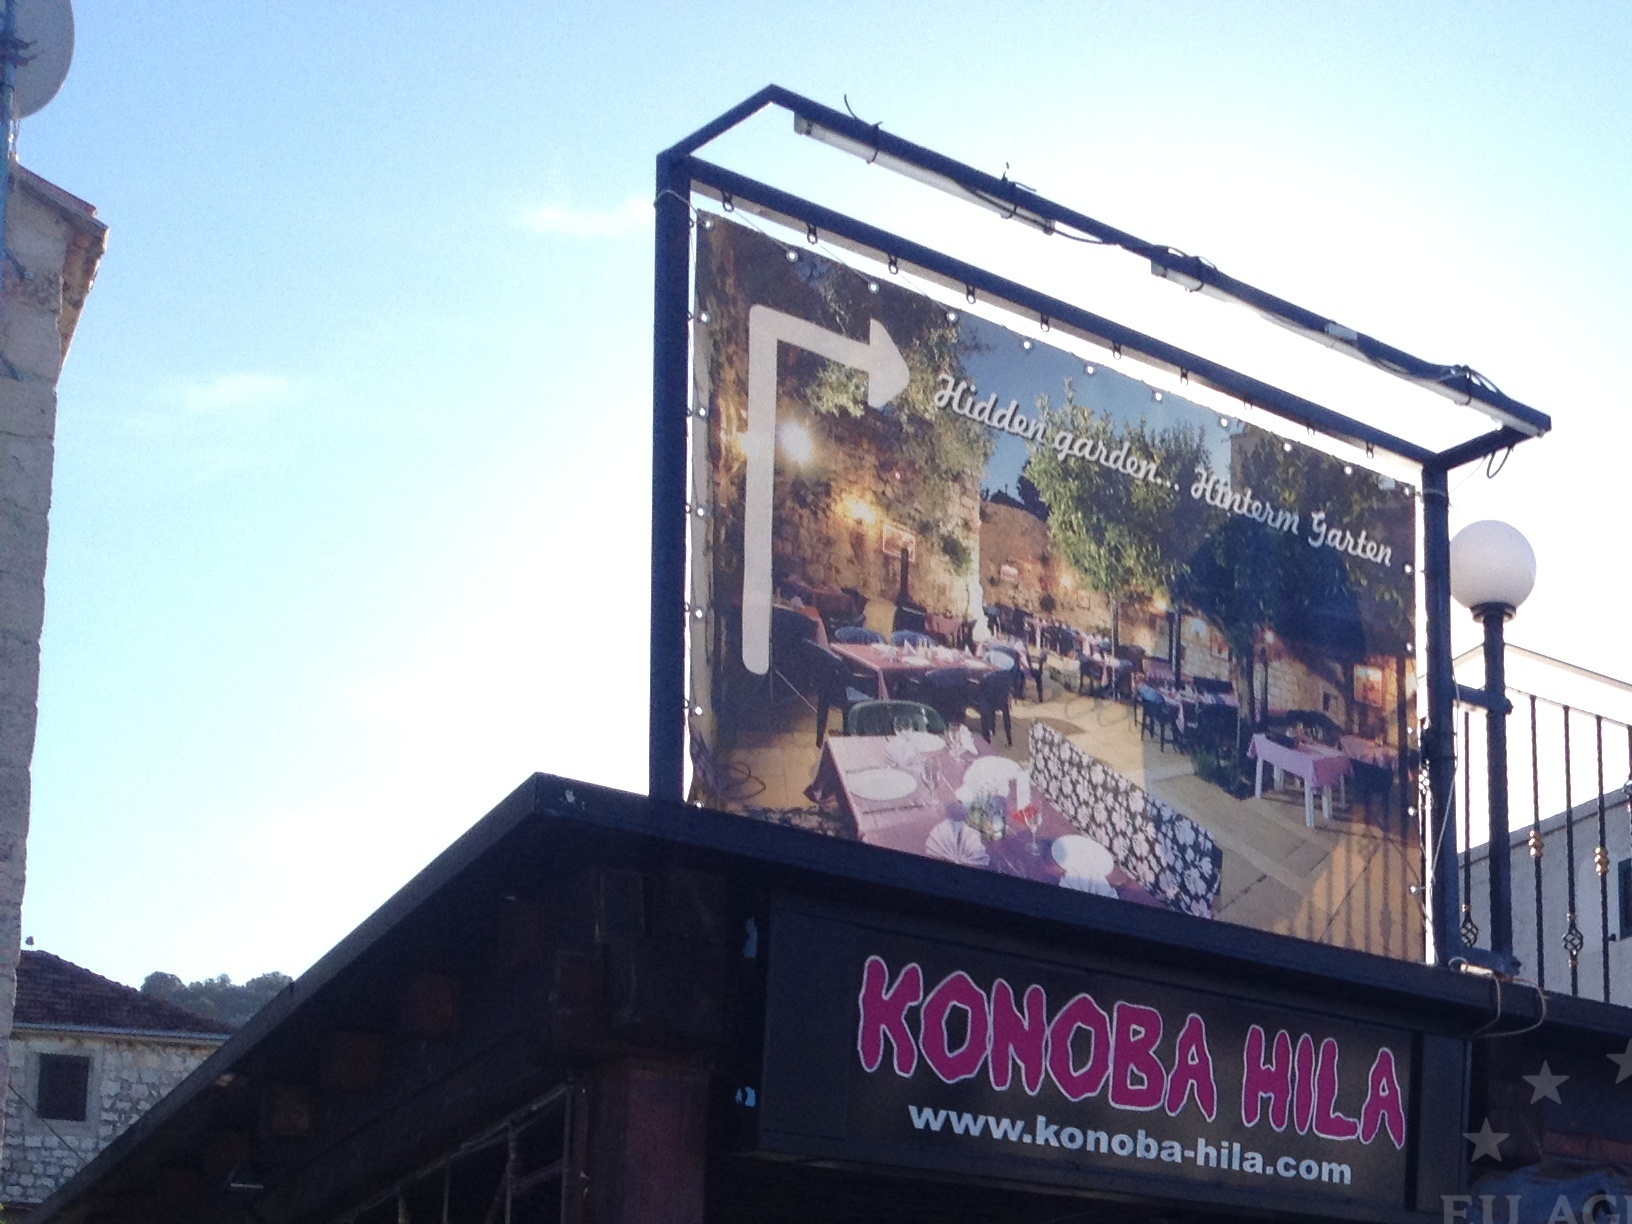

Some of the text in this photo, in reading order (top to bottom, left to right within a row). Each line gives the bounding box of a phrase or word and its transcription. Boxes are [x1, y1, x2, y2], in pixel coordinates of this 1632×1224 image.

[935, 373, 1393, 568] Hidden garden... Hinterm Garten
[857, 954, 1405, 1149] KONOBA HILA
[908, 1104, 1352, 1185] www.konoba-hila.com
